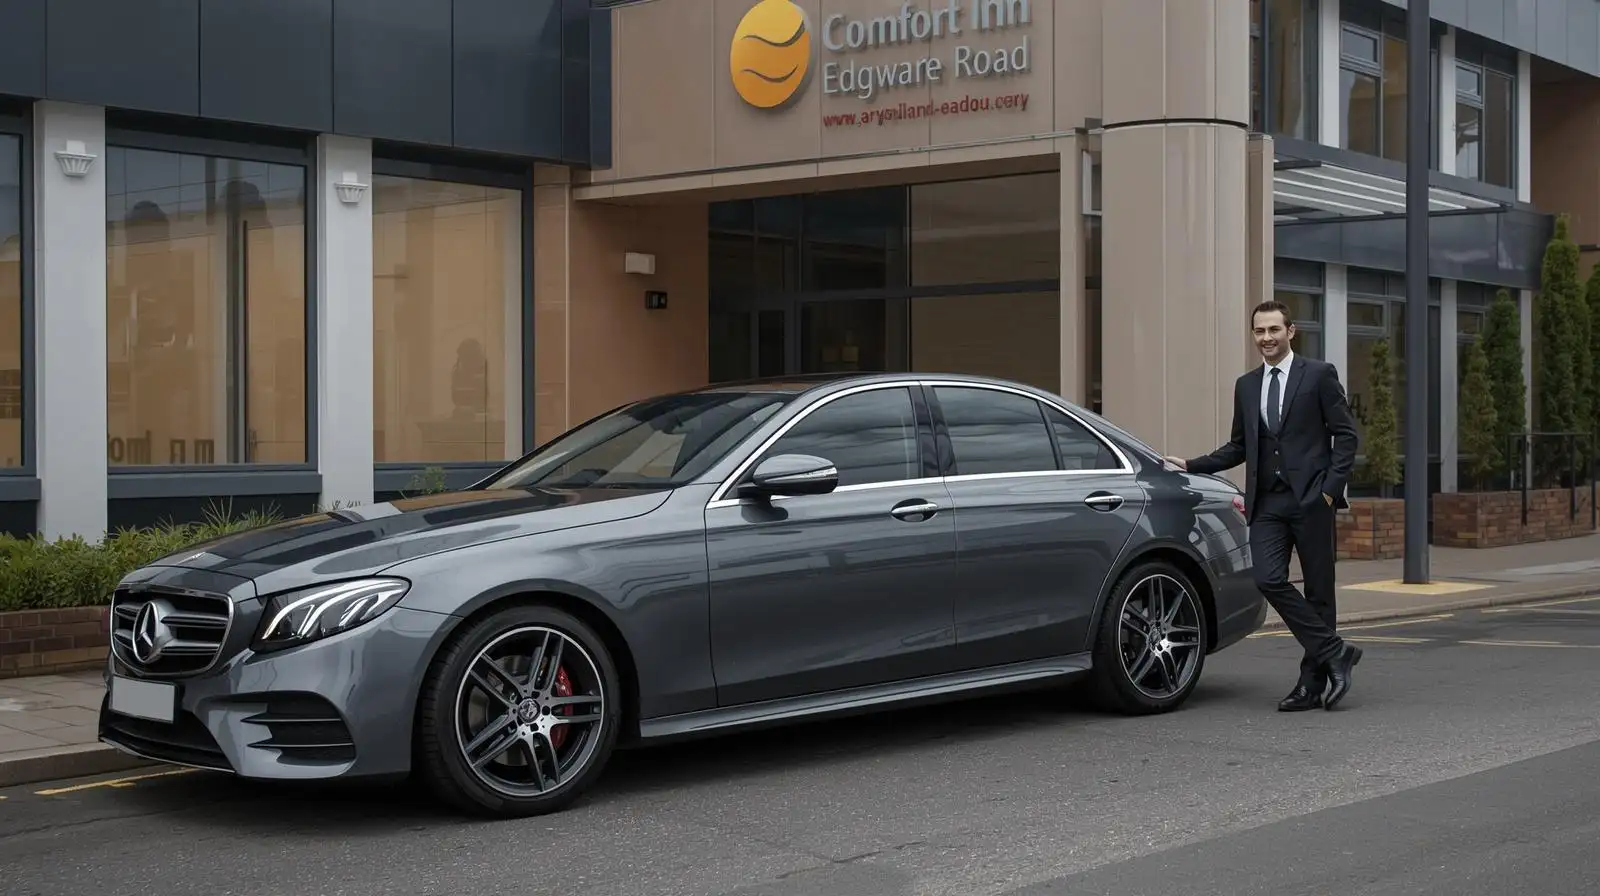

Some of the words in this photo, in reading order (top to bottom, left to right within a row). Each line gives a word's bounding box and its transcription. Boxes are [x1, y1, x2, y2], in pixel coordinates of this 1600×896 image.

[822, 0, 961, 50] Comfort
[971, 0, 1031, 30] Inn
[823, 56, 942, 99] Edgware
[954, 35, 1030, 78] Road
